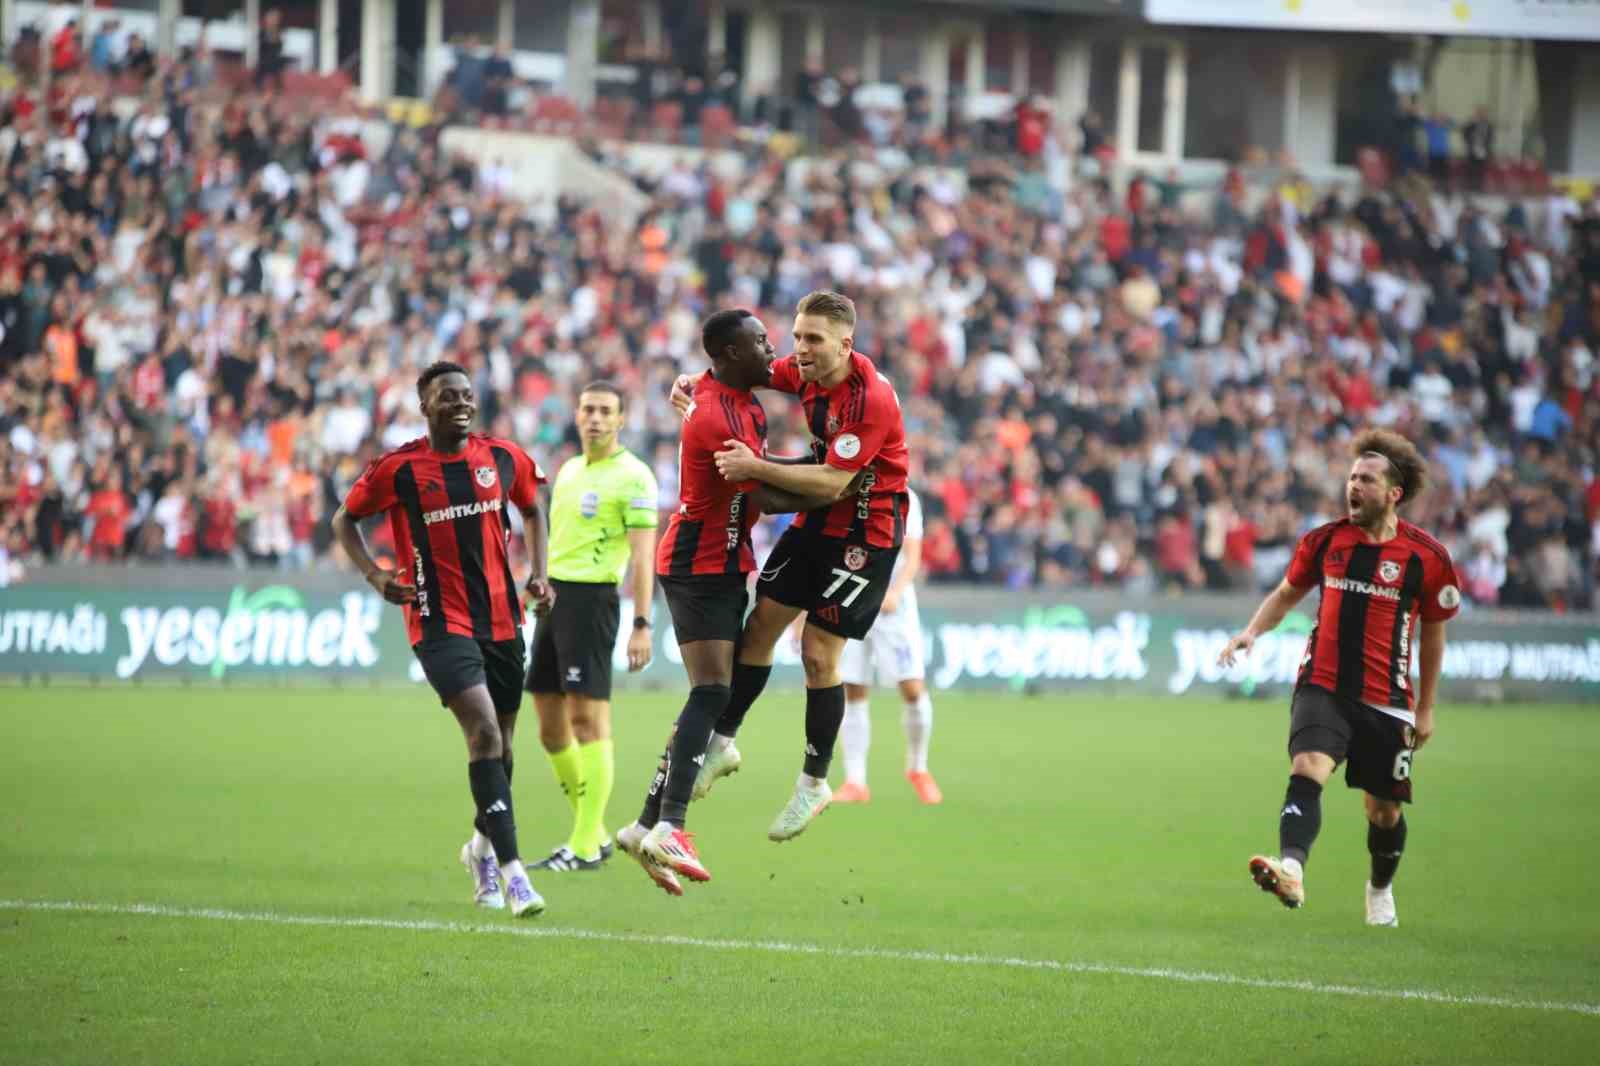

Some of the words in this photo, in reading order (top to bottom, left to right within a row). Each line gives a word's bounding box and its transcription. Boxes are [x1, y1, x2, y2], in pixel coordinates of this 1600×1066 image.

[822, 567, 870, 608] 77
[1324, 575, 1401, 601] EHİTKAMİL
[116, 592, 383, 678] yesemek
[934, 610, 1152, 689] yesemek
[1168, 628, 1309, 694] yesem
